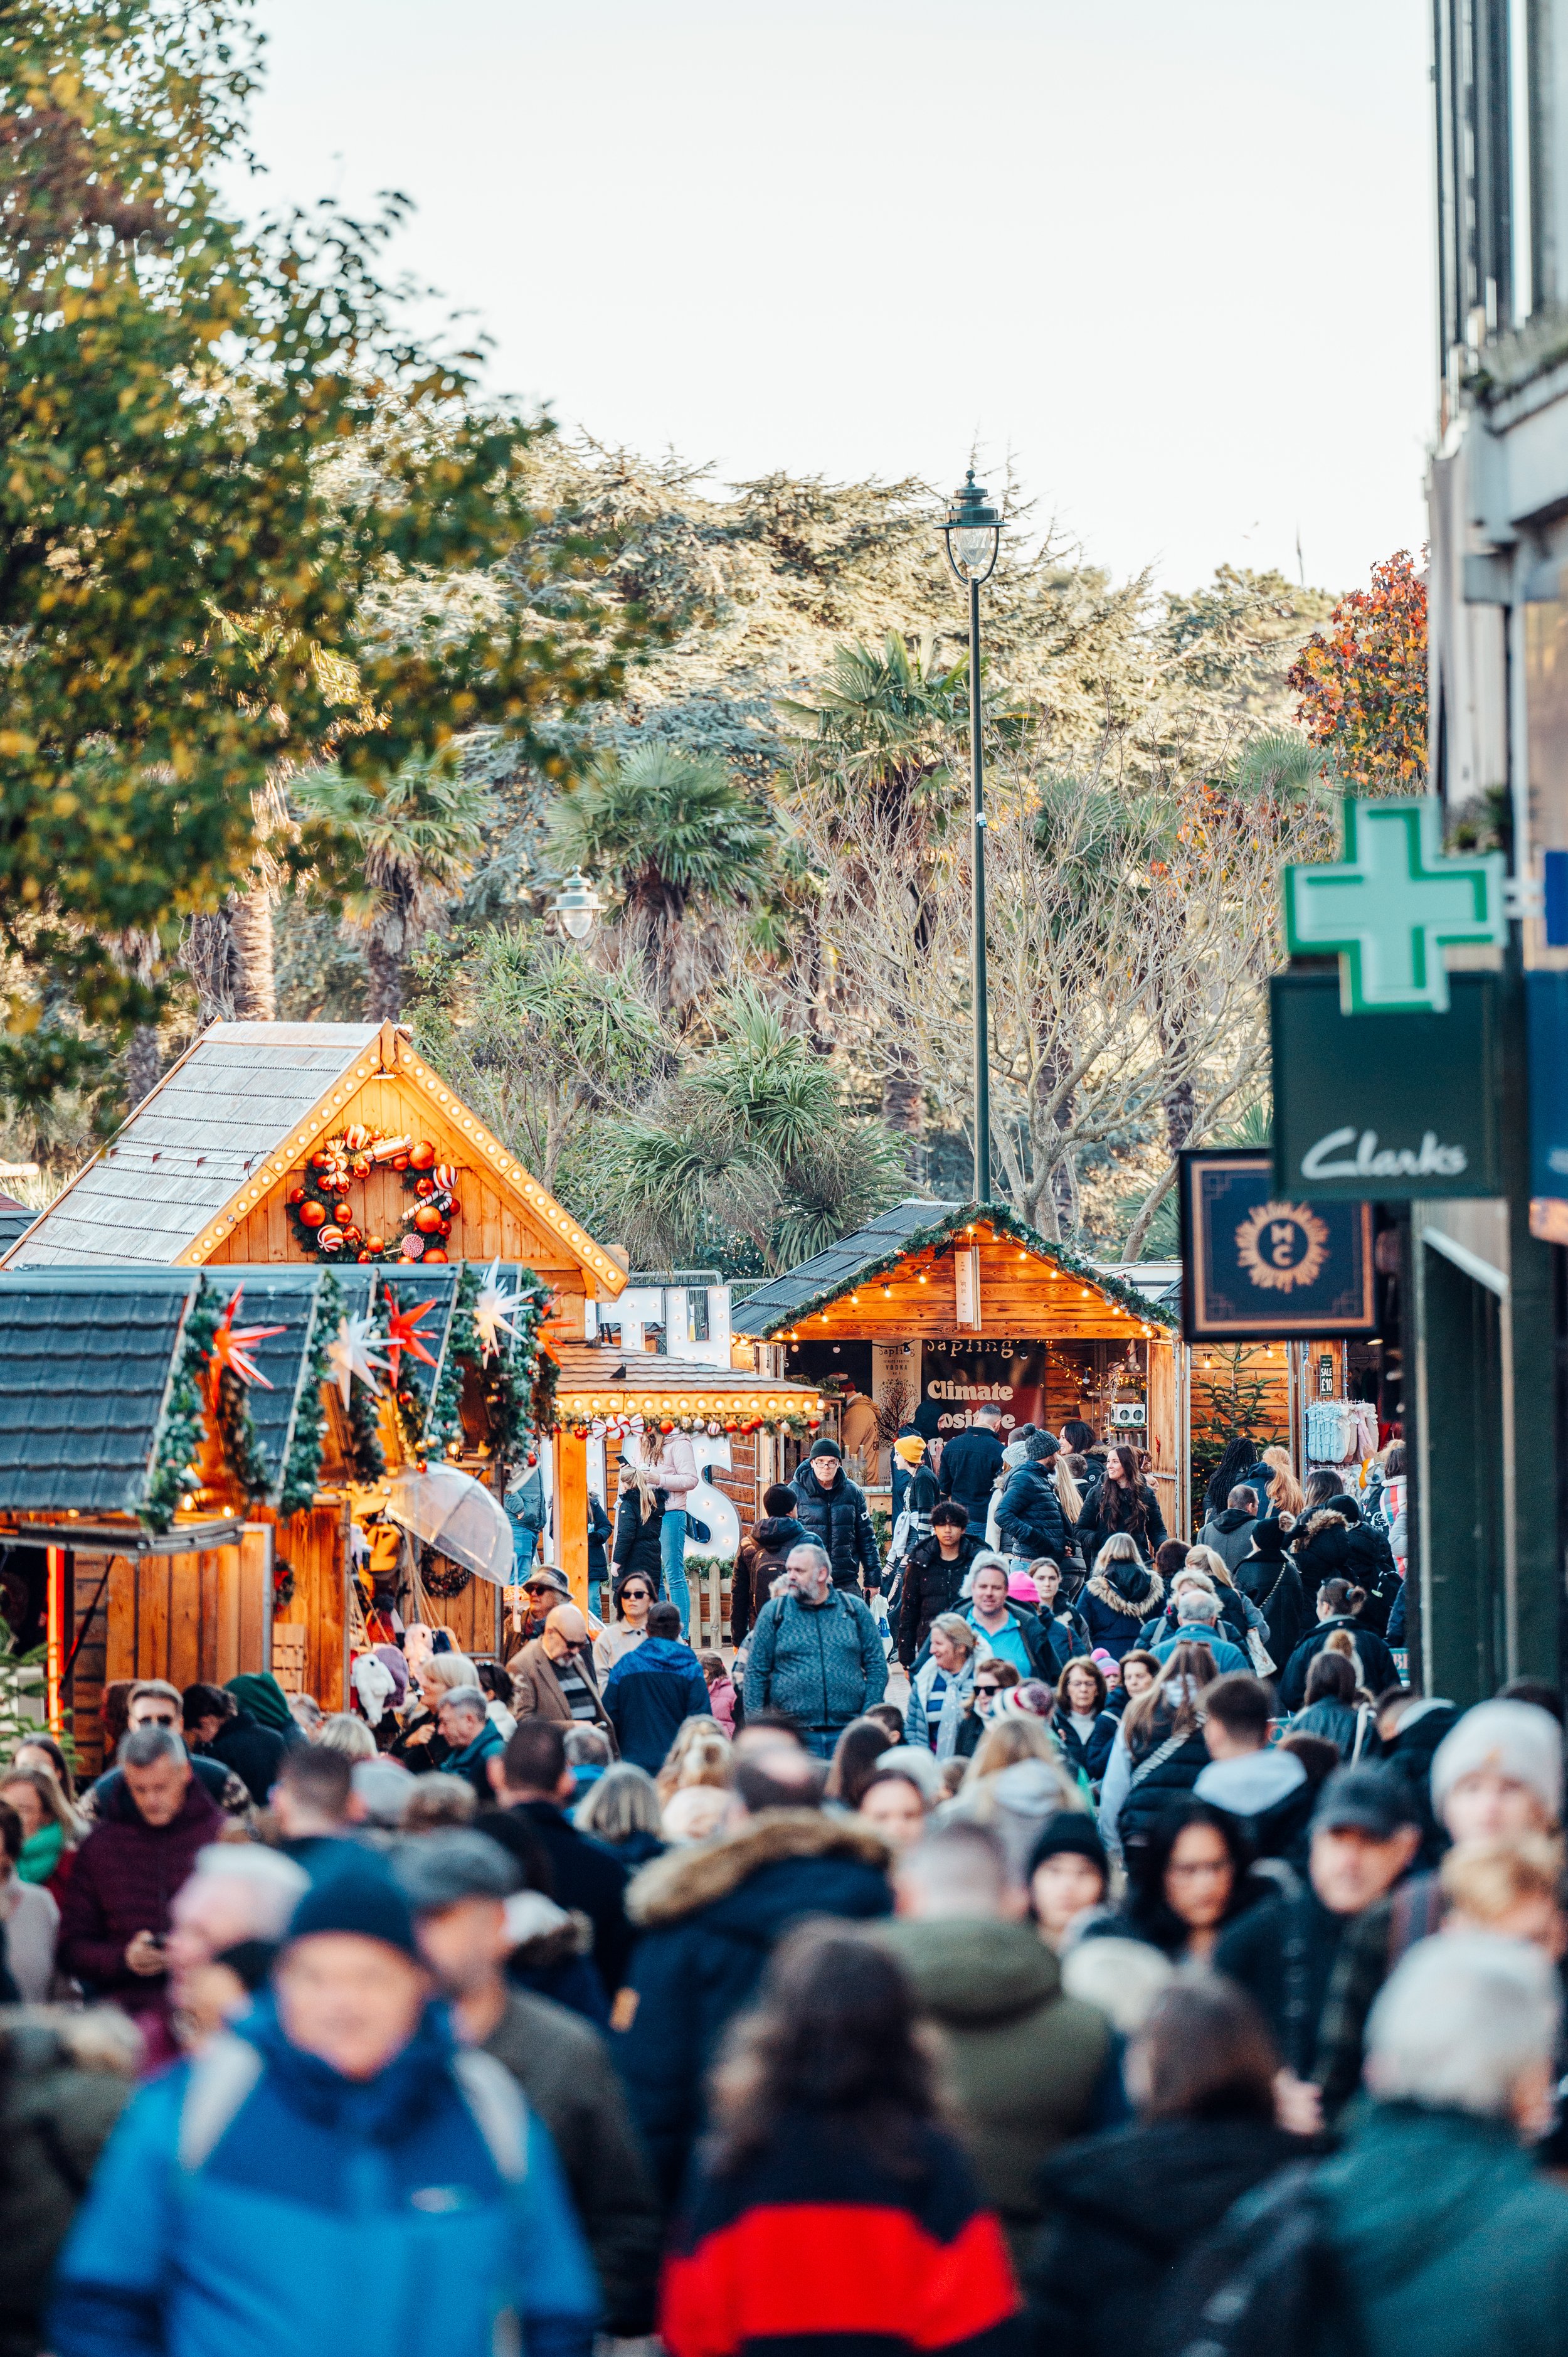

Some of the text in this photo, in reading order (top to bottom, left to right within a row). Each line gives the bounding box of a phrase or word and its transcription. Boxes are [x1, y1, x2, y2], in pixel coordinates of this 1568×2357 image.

[1301, 1126, 1468, 1179] Clarks
[879, 1346, 915, 1358] Saplig
[1320, 1368, 1333, 1376] SALE
[927, 1380, 1014, 1401] Climate
[1321, 1378, 1333, 1391] £10
